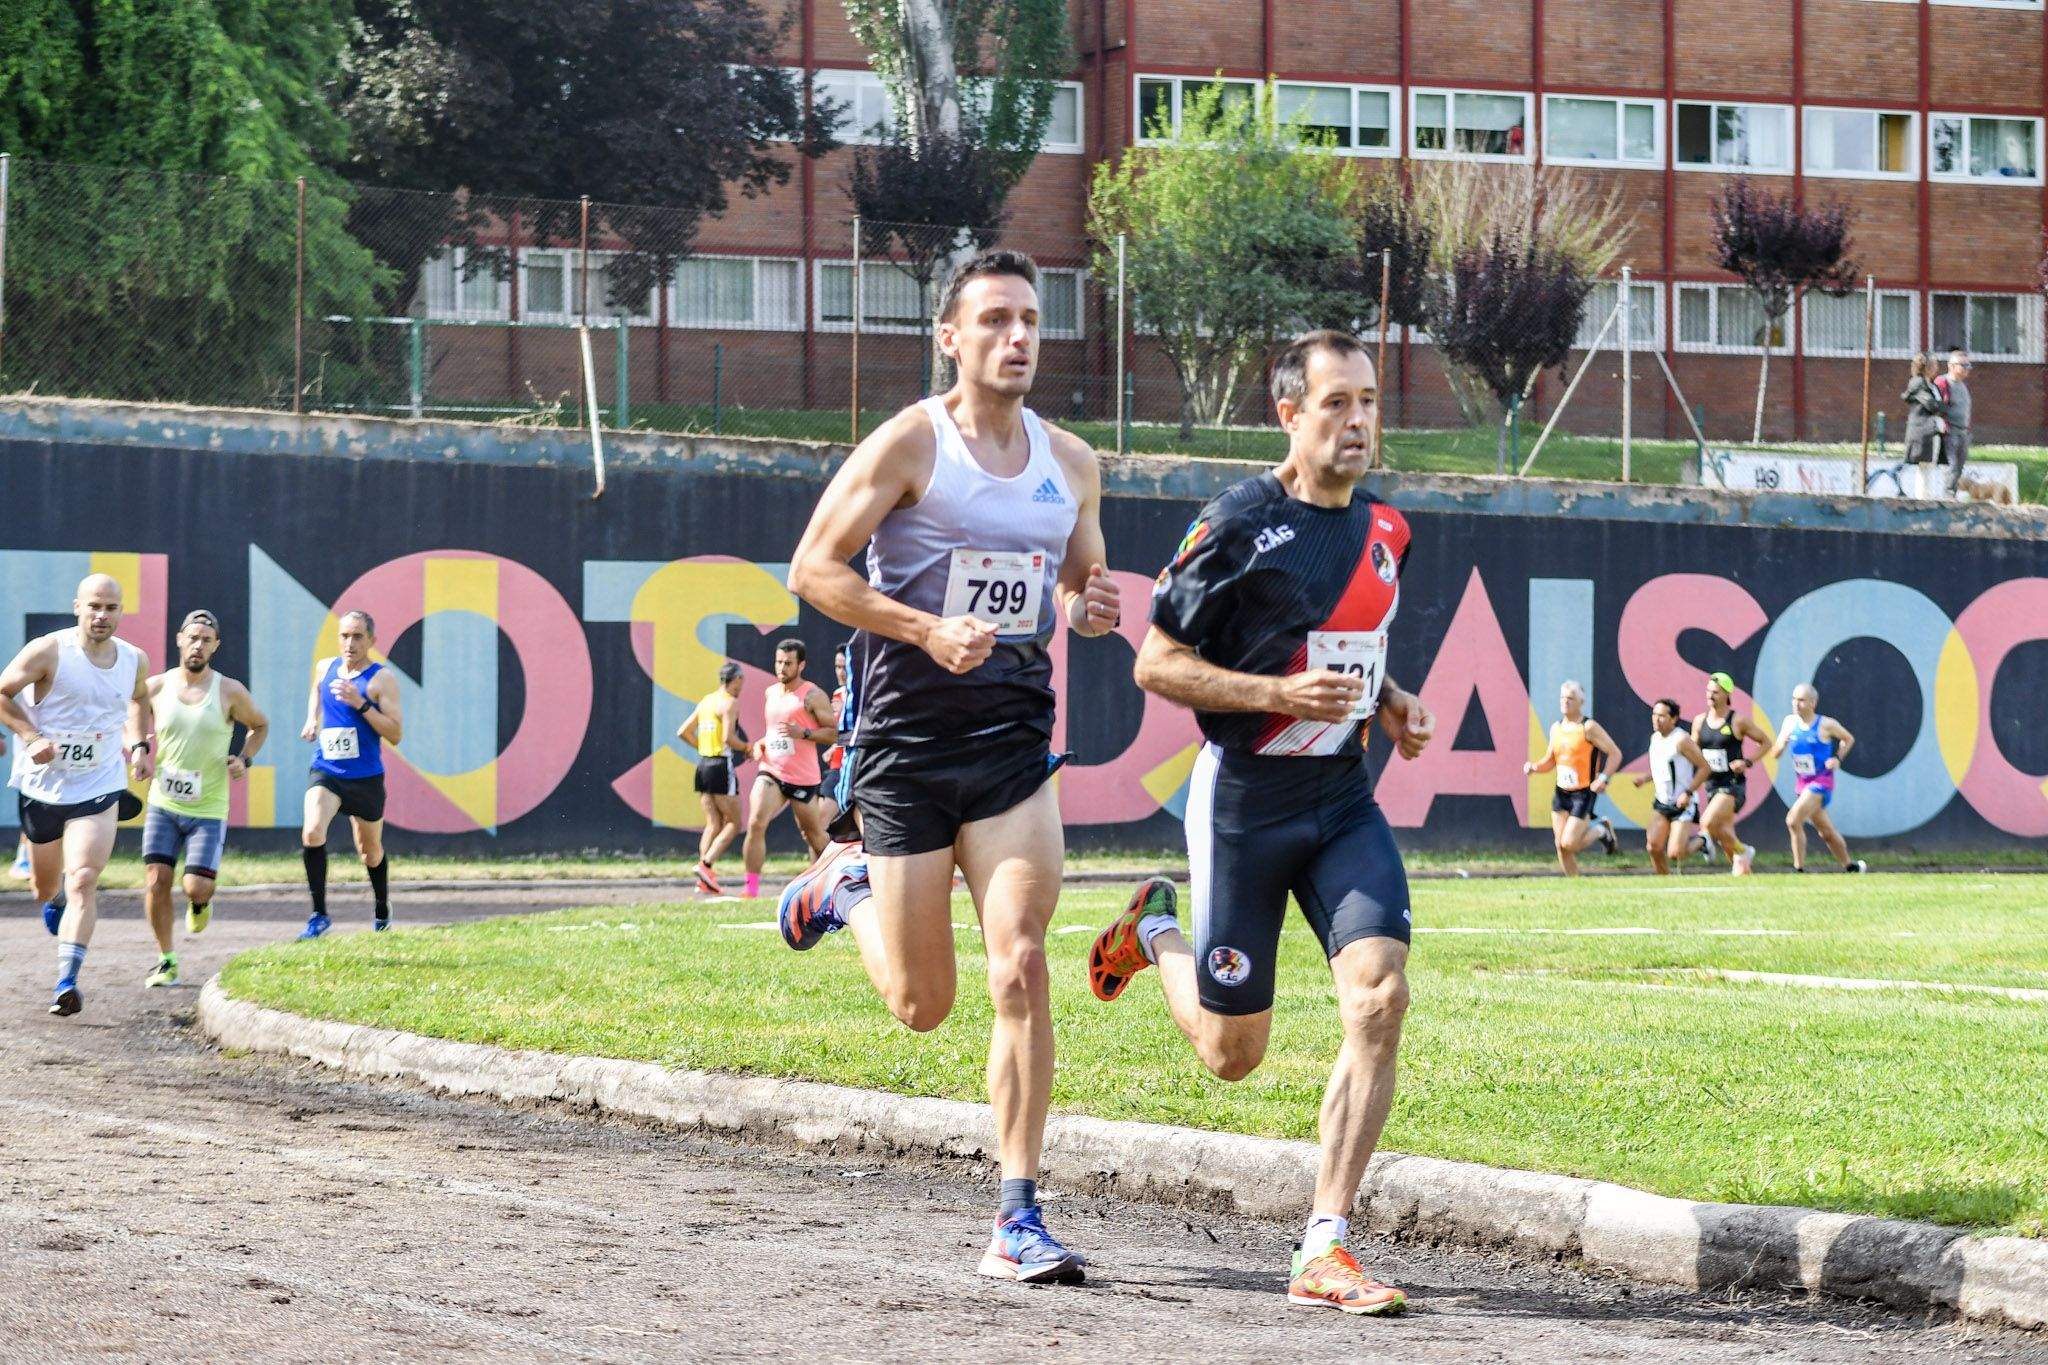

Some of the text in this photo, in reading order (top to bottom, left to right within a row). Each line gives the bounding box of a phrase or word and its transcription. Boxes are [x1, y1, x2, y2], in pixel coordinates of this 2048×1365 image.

[1033, 494, 1065, 504] adidas
[967, 579, 1027, 614] 799
[60, 744, 95, 761] 784
[166, 778, 194, 795] 702
